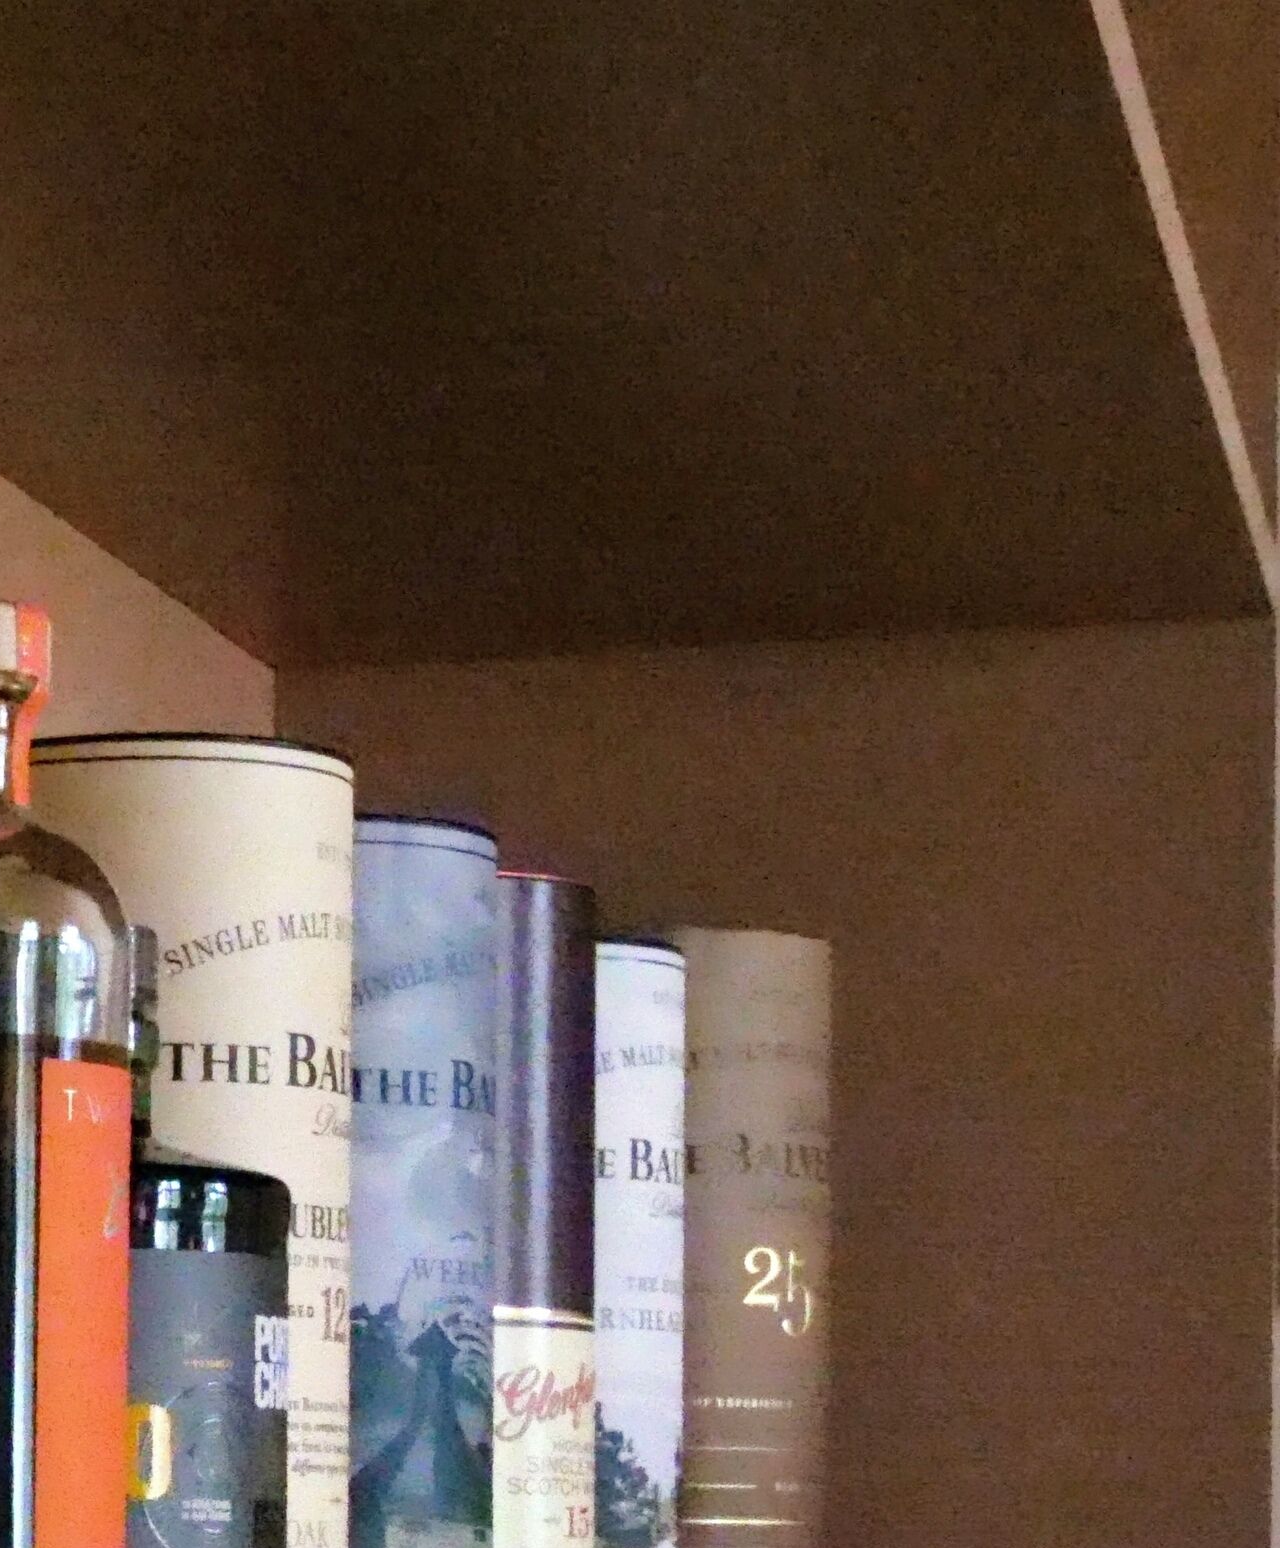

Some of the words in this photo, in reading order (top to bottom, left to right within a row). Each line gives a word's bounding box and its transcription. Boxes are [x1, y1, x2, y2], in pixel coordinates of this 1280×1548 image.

[164, 918, 270, 977] SINGLE
[278, 912, 331, 942] MALT
[161, 1041, 272, 1086] THE
